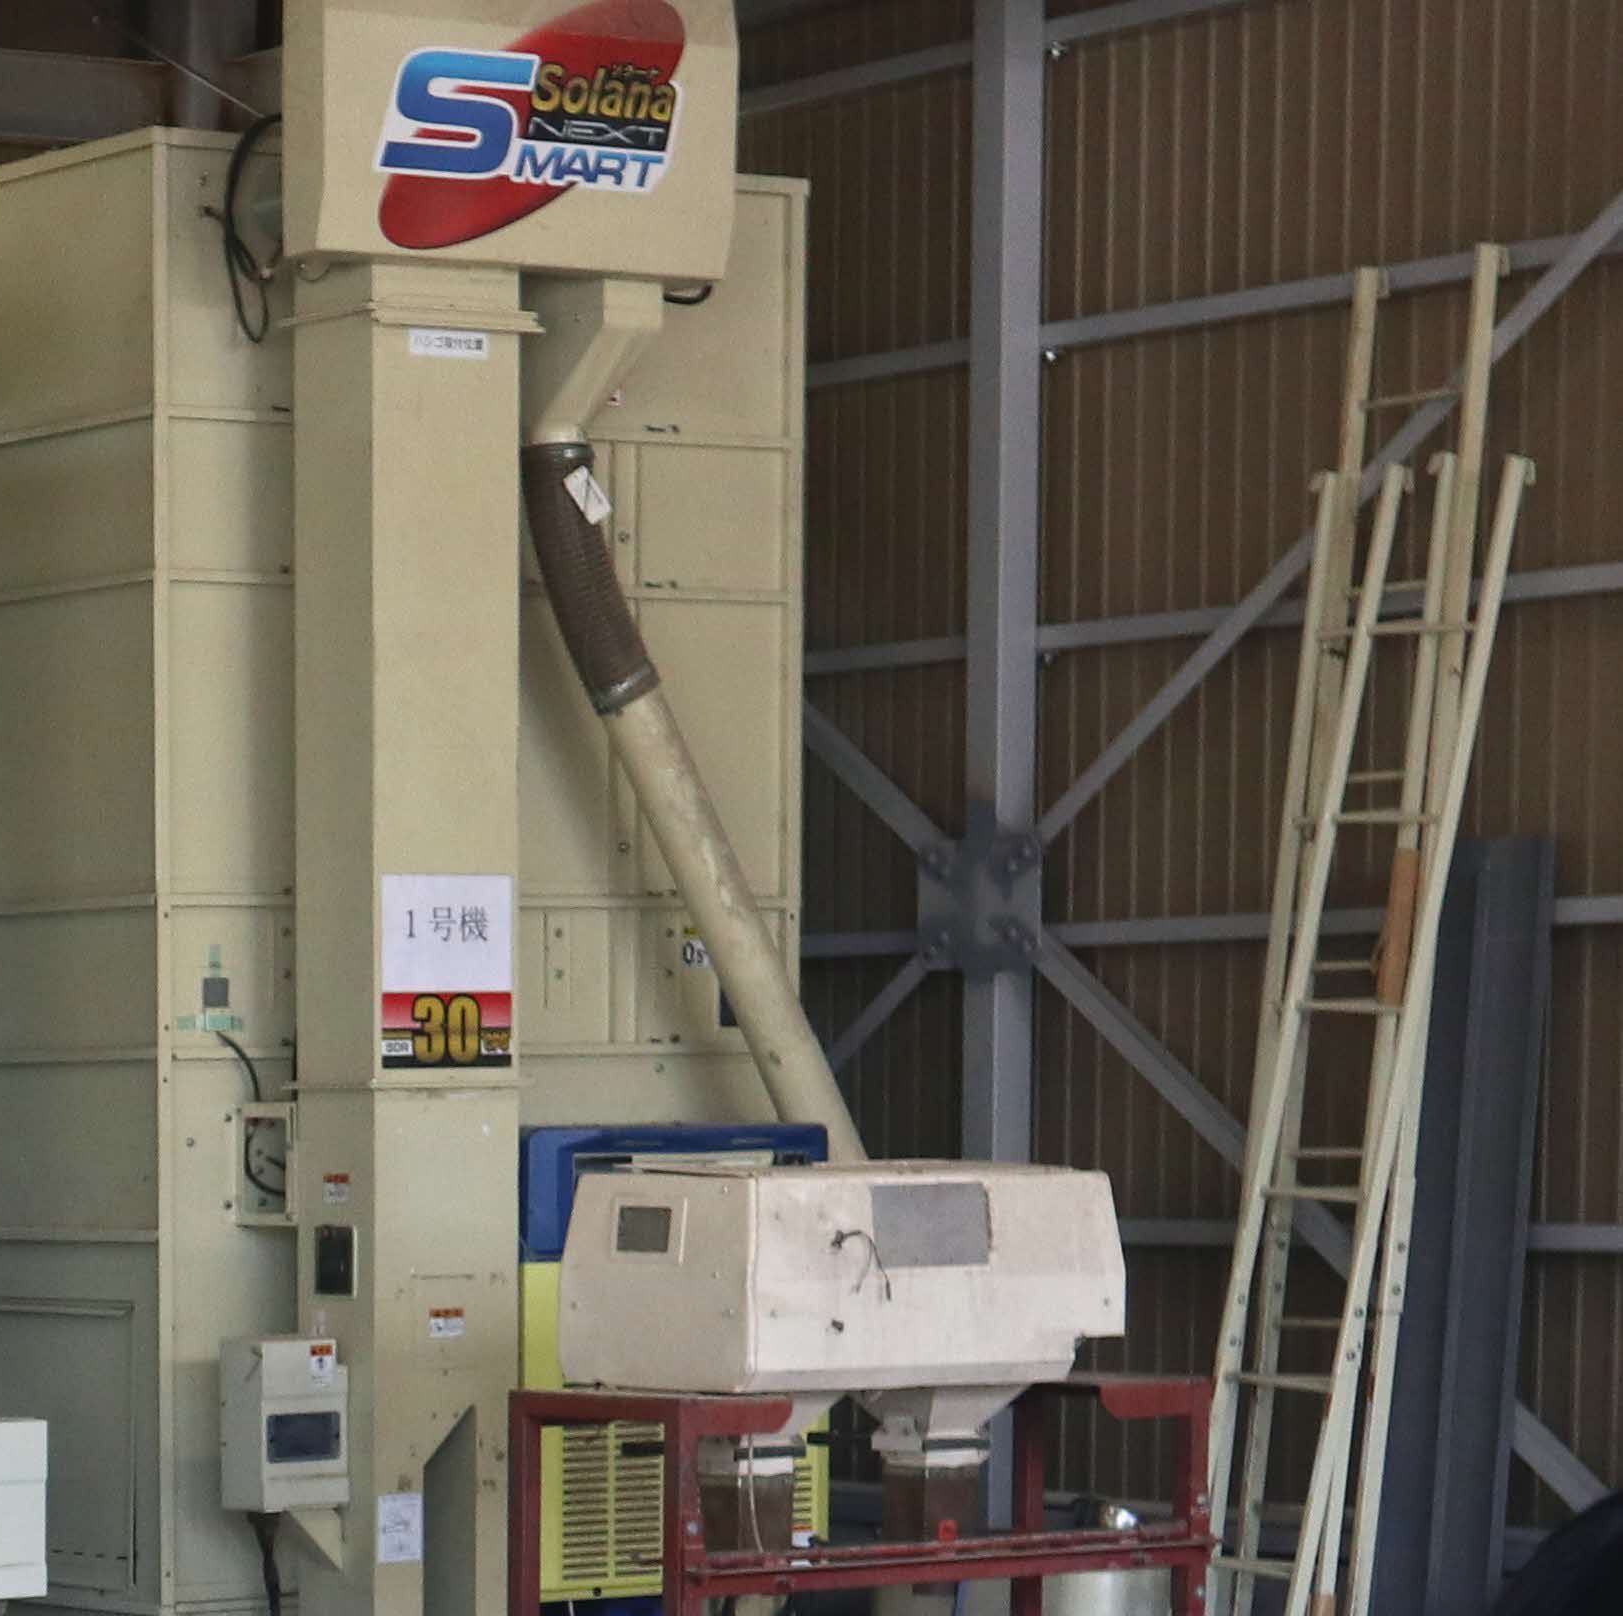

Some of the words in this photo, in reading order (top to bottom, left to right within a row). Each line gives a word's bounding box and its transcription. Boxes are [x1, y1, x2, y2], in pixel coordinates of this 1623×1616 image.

[531, 63, 675, 122] Solana
[528, 116, 665, 146] NEXT
[405, 906, 489, 943] 1号機
[412, 993, 482, 1064] 30
